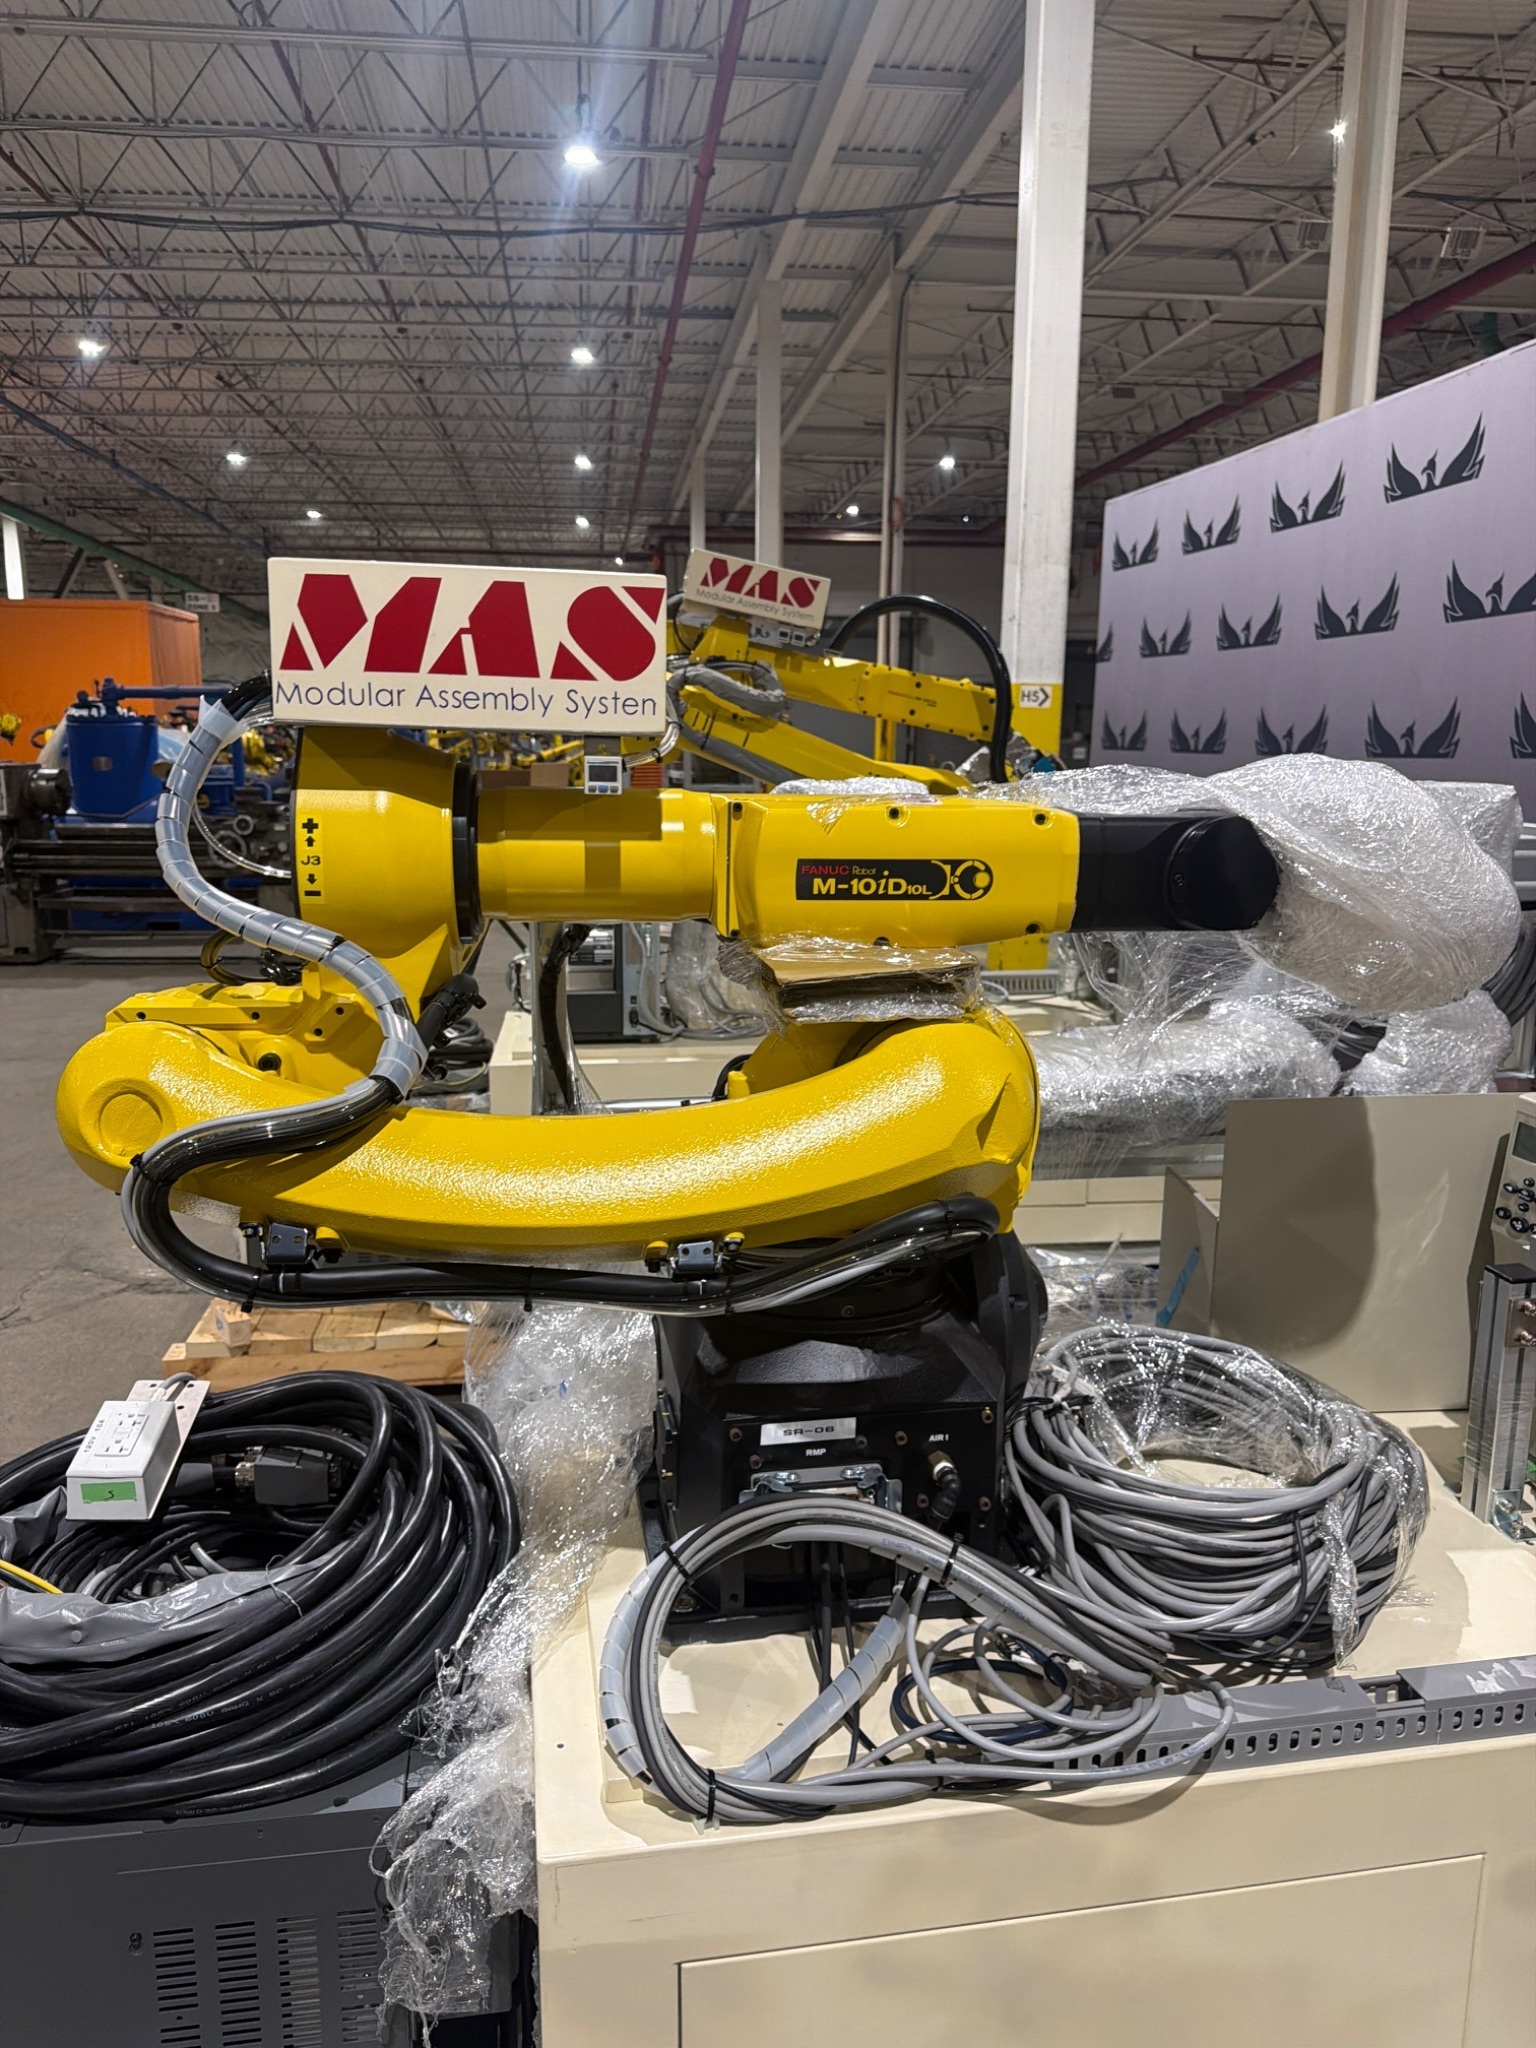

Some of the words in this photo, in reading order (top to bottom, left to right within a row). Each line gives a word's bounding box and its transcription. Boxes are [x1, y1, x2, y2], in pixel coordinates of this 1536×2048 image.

[700, 557, 821, 609] MAS
[695, 588, 736, 604] Modular
[738, 599, 780, 615] Assembly
[782, 608, 815, 621] System
[280, 573, 666, 682] MAS
[275, 681, 406, 708] Modular
[415, 684, 554, 718] Assembly
[301, 855, 321, 866] J3
[801, 865, 850, 875] FANUC
[852, 865, 877, 876] Robot
[805, 1448, 827, 1457] RMP
